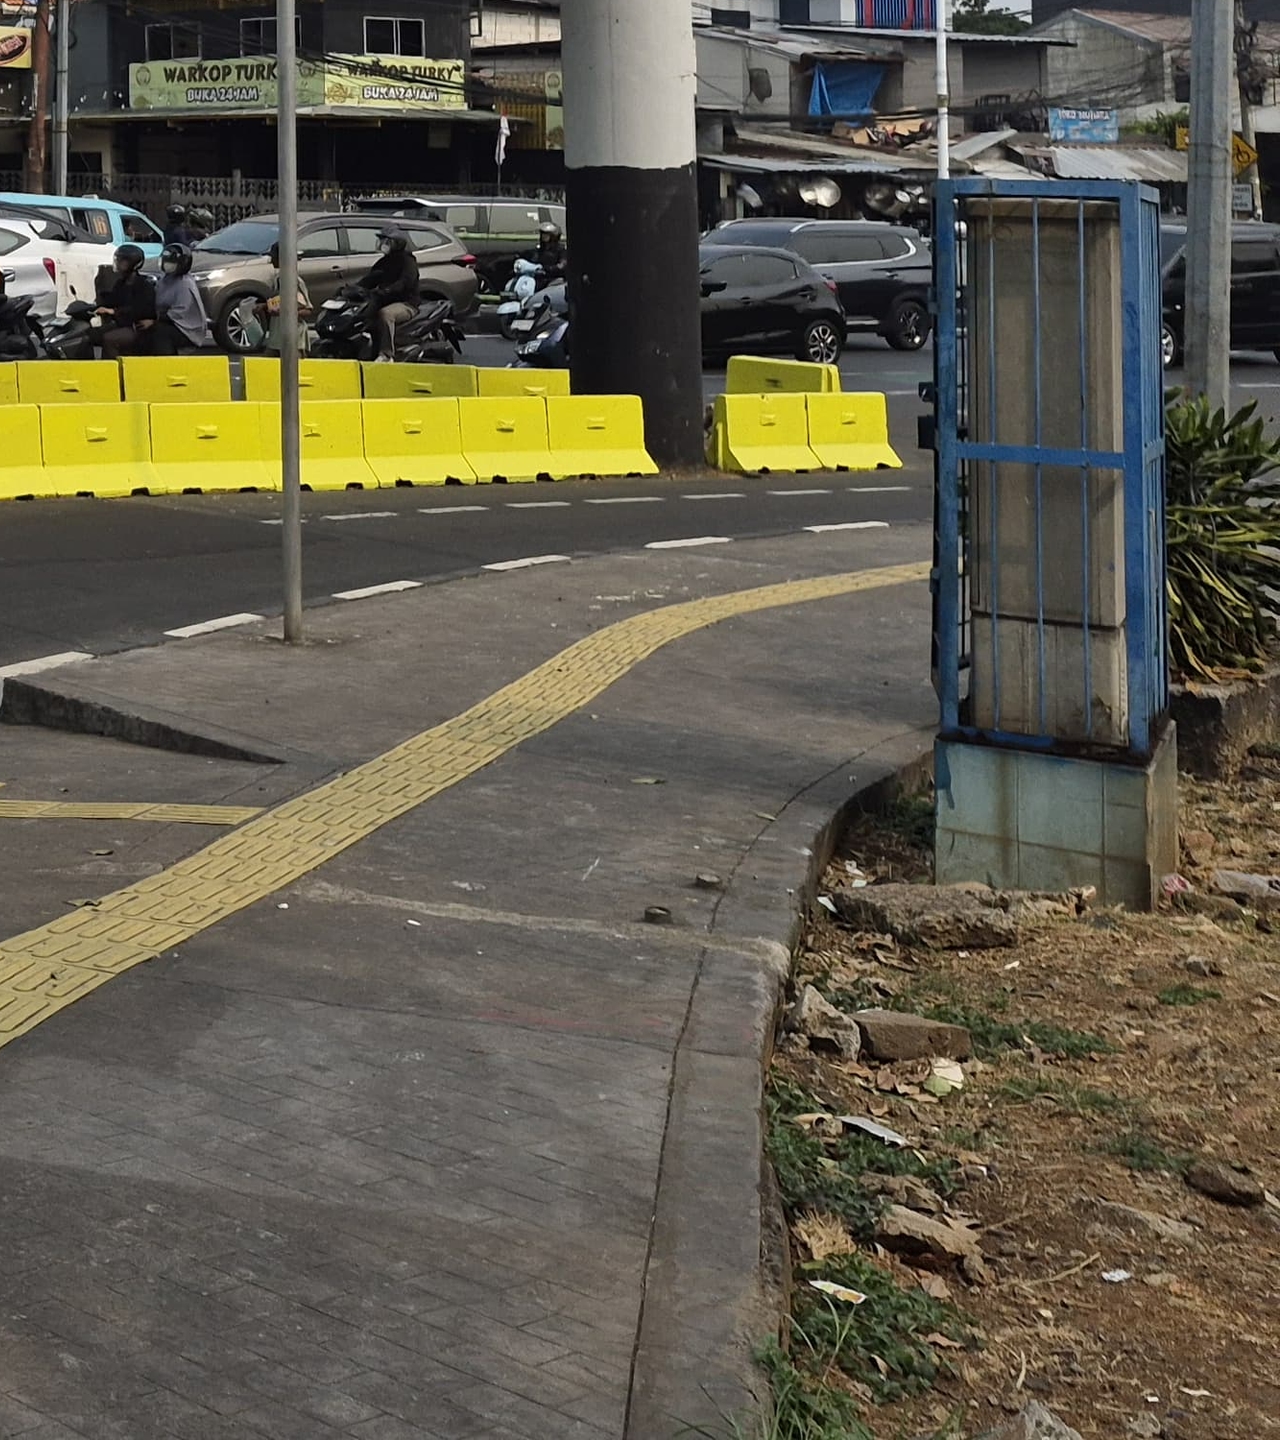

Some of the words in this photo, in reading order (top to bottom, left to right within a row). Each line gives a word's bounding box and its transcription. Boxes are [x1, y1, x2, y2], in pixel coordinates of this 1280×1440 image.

[164, 64, 232, 83] WARKOP
[236, 63, 278, 81] TURK
[410, 65, 455, 80] TURKY
[187, 86, 217, 103] BUKA
[219, 86, 233, 101] 24
[234, 86, 259, 102] JAM
[363, 85, 396, 100] BUKA
[396, 86, 413, 100] 24
[414, 87, 440, 101] JAM
